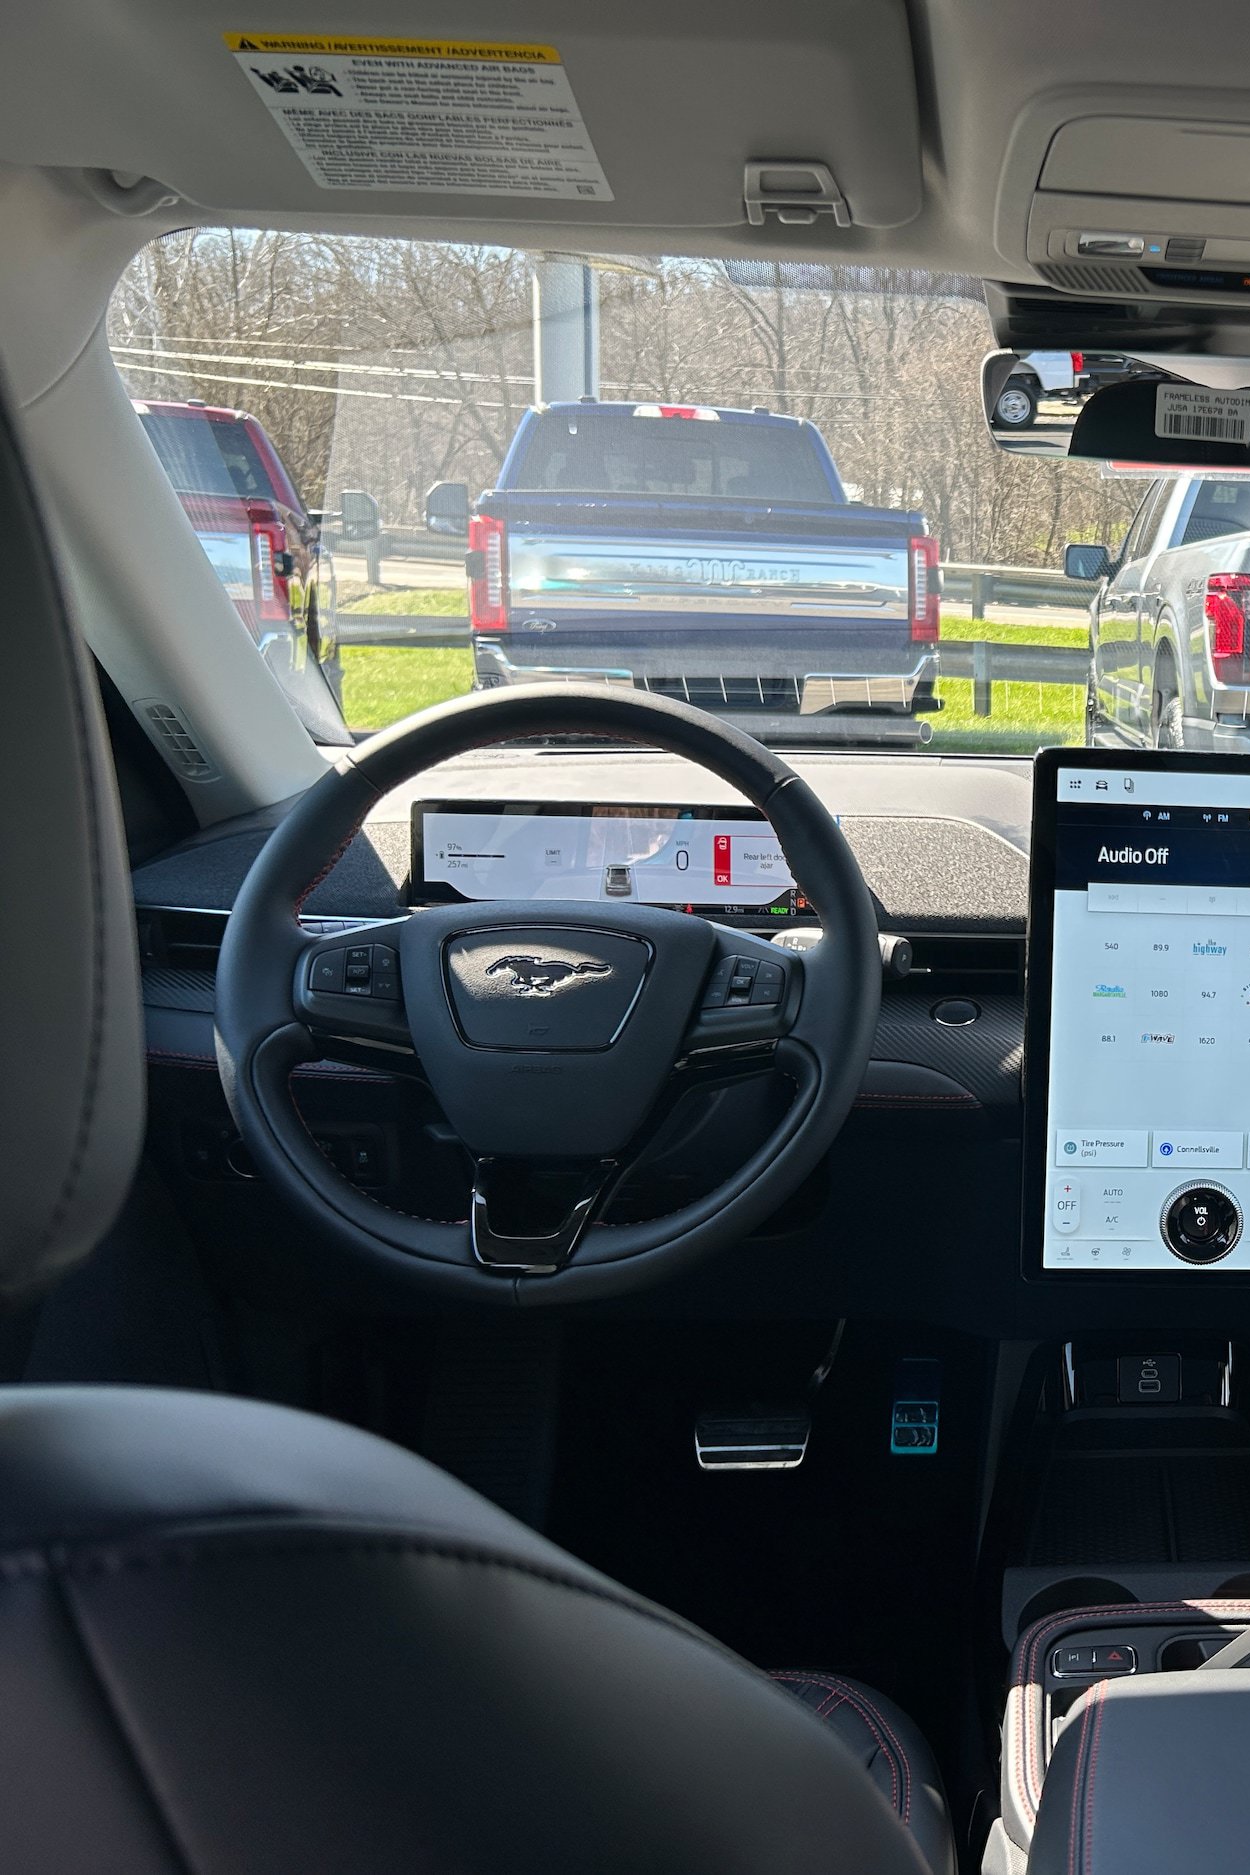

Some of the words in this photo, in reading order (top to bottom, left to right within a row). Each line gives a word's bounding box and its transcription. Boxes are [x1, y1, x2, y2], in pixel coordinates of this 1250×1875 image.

[261, 40, 327, 51] WARNING
[352, 59, 382, 67] EVEN
[385, 60, 415, 69] WITH
[417, 62, 478, 72] ADVANCED
[481, 64, 500, 73] AIR
[503, 65, 536, 75] BAGS
[380, 151, 403, 159] CON
[1164, 392, 1210, 403] FRAMELESS
[1215, 396, 1250, 407] AUTODIM
[1157, 811, 1170, 821] AM
[1217, 813, 1229, 823] FM
[743, 852, 759, 861] Rear
[760, 853, 772, 862] left
[1097, 845, 1143, 865] Audio
[1144, 847, 1170, 865] Off
[676, 850, 690, 871] 0
[760, 862, 773, 870] ajar
[716, 873, 729, 883] OK
[790, 889, 796, 898] R
[790, 898, 797, 907] N
[770, 907, 788, 915] READY
[1104, 942, 1119, 951] 540
[1153, 943, 1170, 952] 89.9
[1192, 942, 1228, 956] highway
[1151, 989, 1169, 998] 1080
[1201, 991, 1217, 999] 94.7
[1101, 1035, 1116, 1043] 88.1
[1199, 1037, 1216, 1045] 1620
[1081, 1139, 1094, 1147] Tire
[1095, 1140, 1124, 1149] Pressure
[1081, 1150, 1097, 1159] (psi)
[1176, 1145, 1220, 1154] Connellsville
[1103, 1188, 1124, 1196] AUTO
[1057, 1200, 1077, 1211] OFF
[1194, 1206, 1208, 1215] VOL
[1105, 1215, 1119, 1224] A/C
